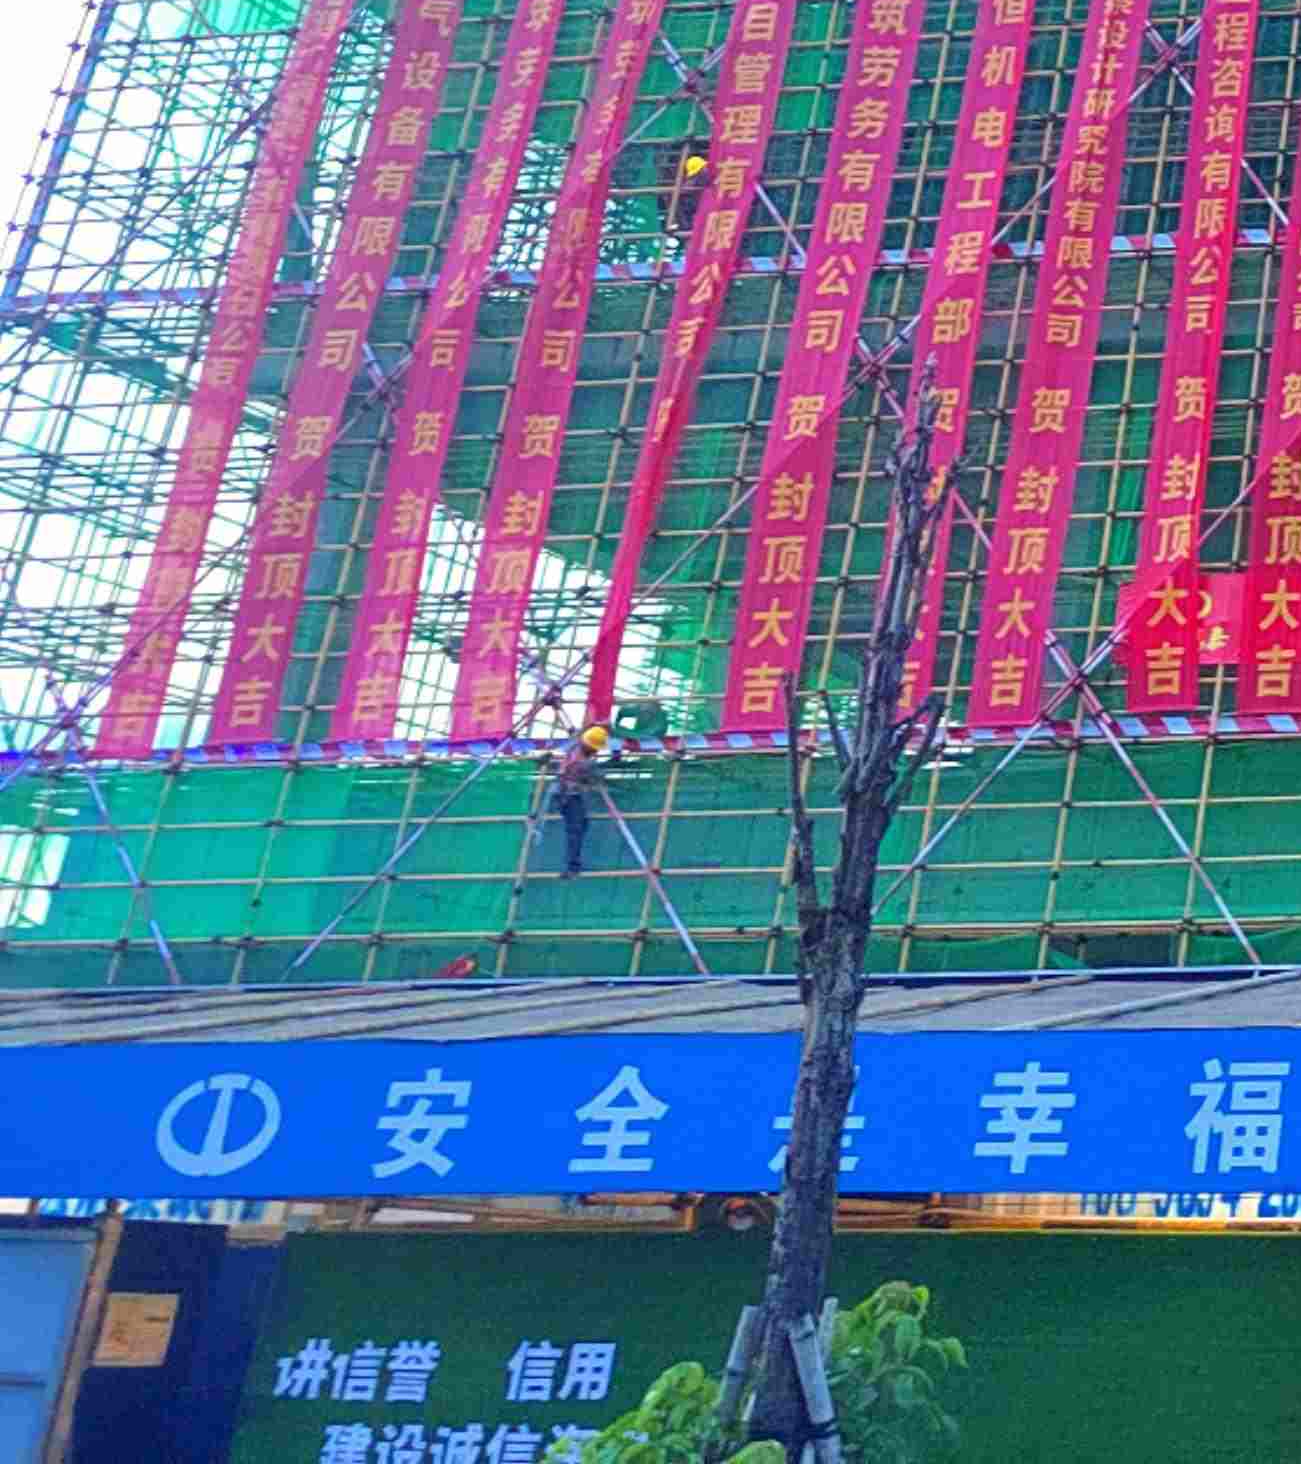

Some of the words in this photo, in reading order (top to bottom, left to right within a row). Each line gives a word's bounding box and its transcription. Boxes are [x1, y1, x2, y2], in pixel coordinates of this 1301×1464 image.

[272, 1337, 441, 1403] 讲信誉
[503, 1339, 617, 1401] 信用
